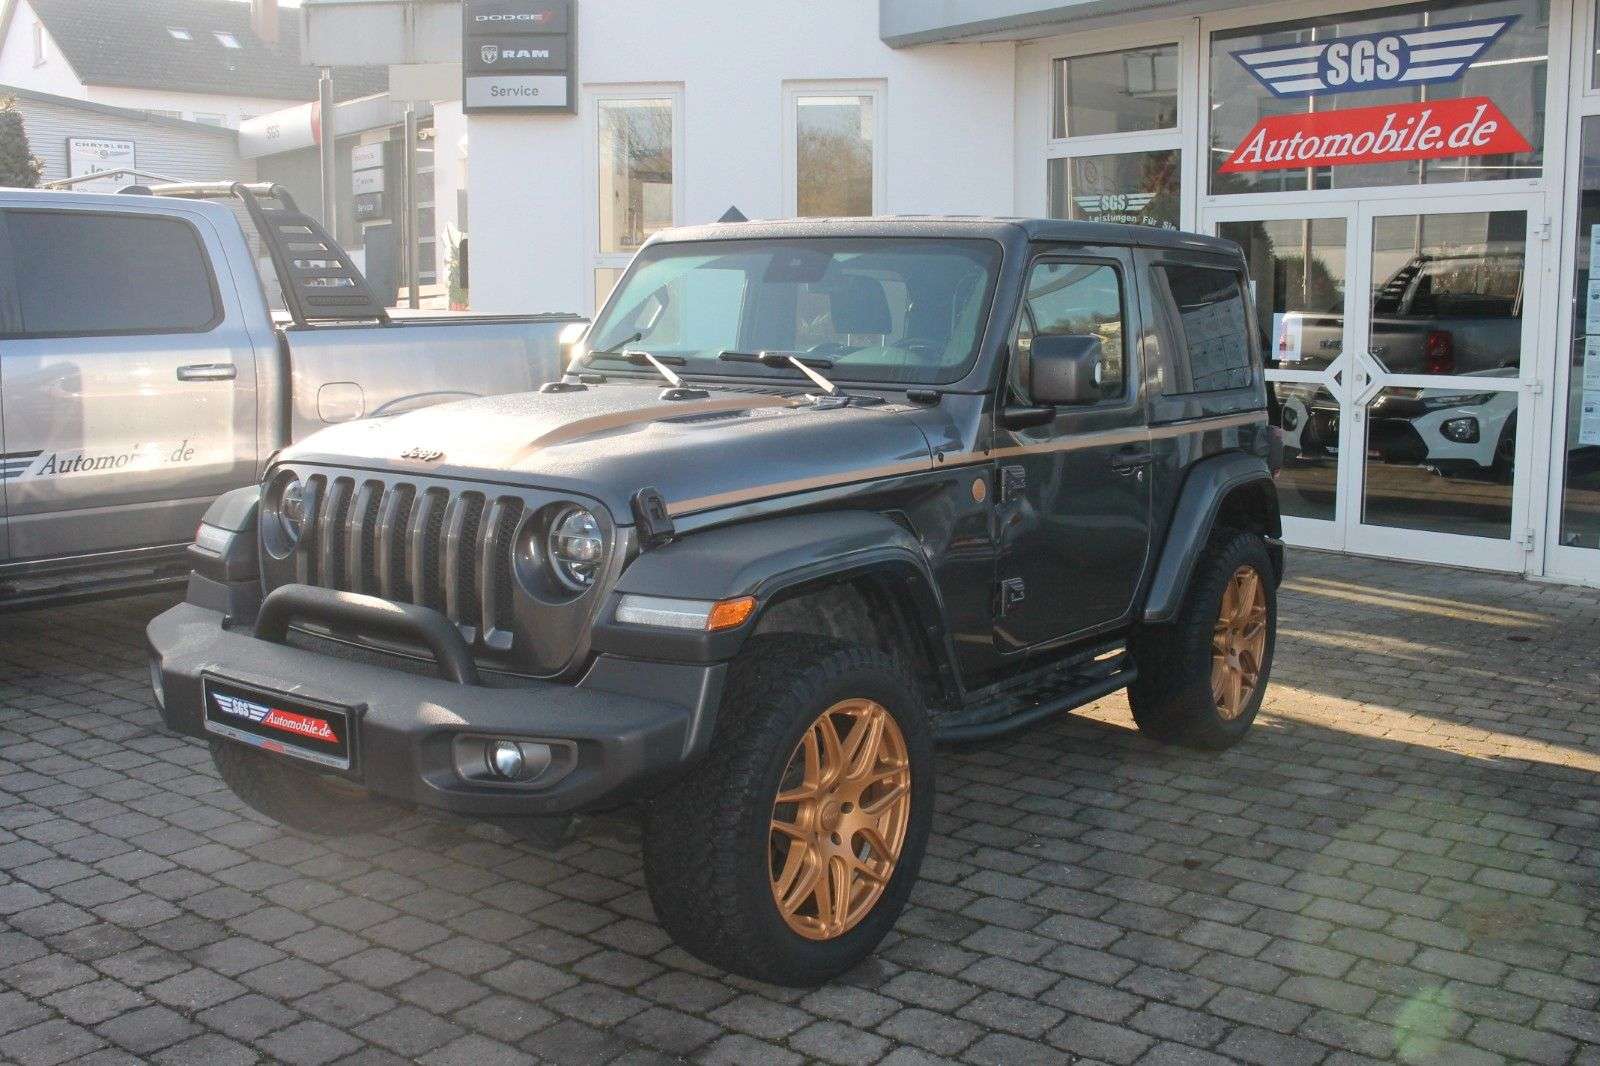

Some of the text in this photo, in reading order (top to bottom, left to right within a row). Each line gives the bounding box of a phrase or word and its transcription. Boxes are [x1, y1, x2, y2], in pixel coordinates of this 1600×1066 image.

[475, 14, 544, 22] DODGE
[502, 50, 549, 58] RAM
[1327, 37, 1400, 86] SGS
[490, 85, 539, 97] Service
[1234, 104, 1498, 164] Automobile.de
[1101, 194, 1126, 210] SGS
[1088, 214, 1137, 223] Leistungen
[232, 699, 332, 738] SGS Automobile.de
